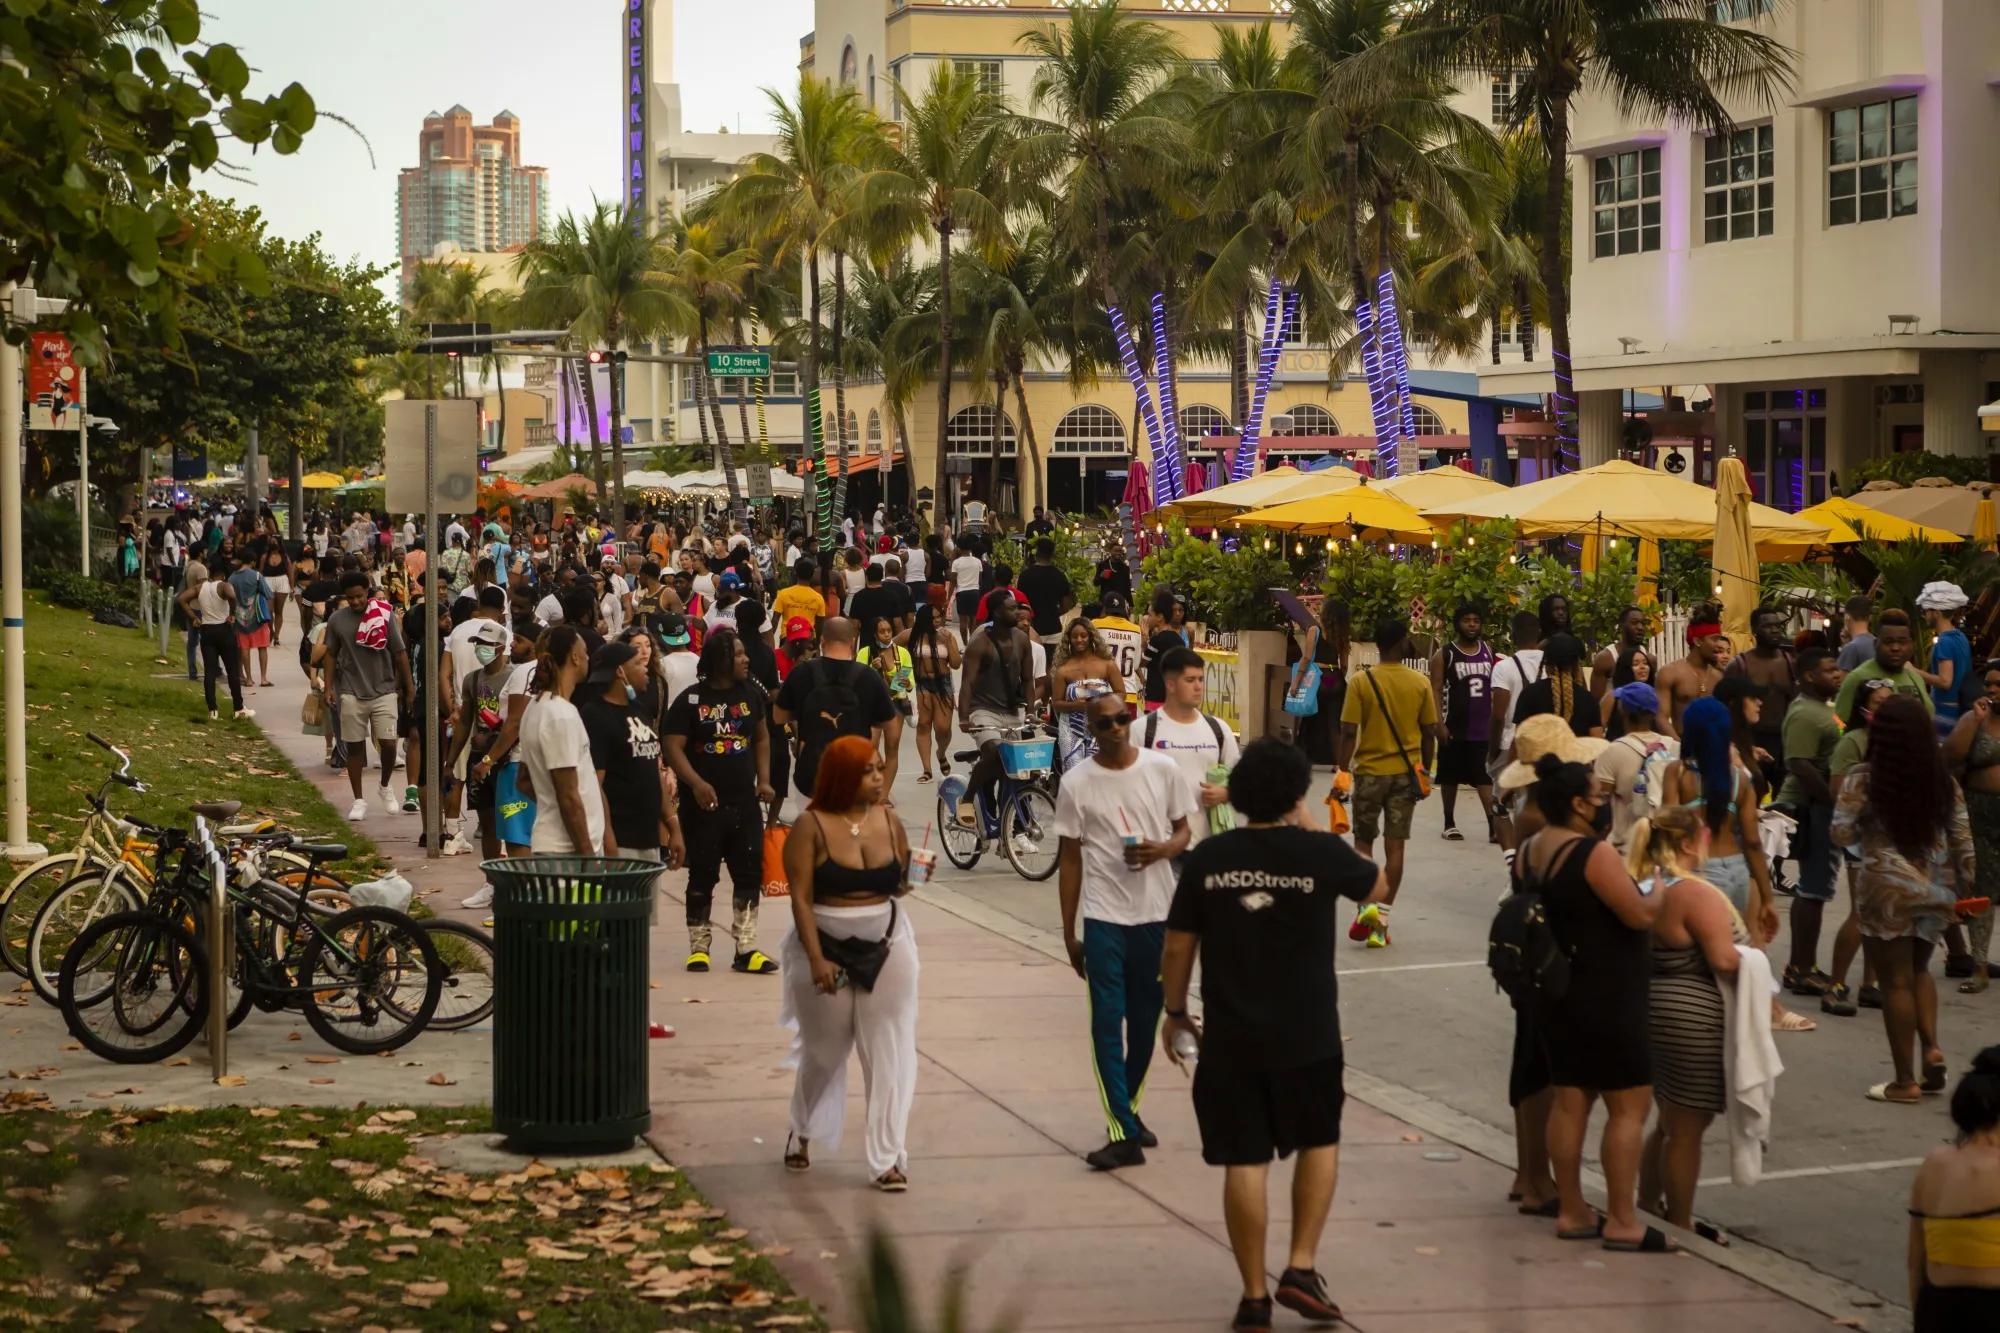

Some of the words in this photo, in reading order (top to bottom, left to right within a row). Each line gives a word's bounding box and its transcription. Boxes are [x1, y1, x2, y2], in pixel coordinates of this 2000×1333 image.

[717, 355, 730, 366] 10
[734, 356, 761, 366] Street
[756, 367, 768, 375] Way
[753, 465, 763, 473] NO
[1108, 632, 1132, 641] SUBBAN
[1455, 662, 1492, 680] KINGS
[1469, 678, 1483, 697] 2
[699, 703, 727, 721] PAY
[729, 702, 751, 718] ME
[1156, 740, 1217, 752] Champion
[1204, 870, 1314, 893] #MSDStrong
